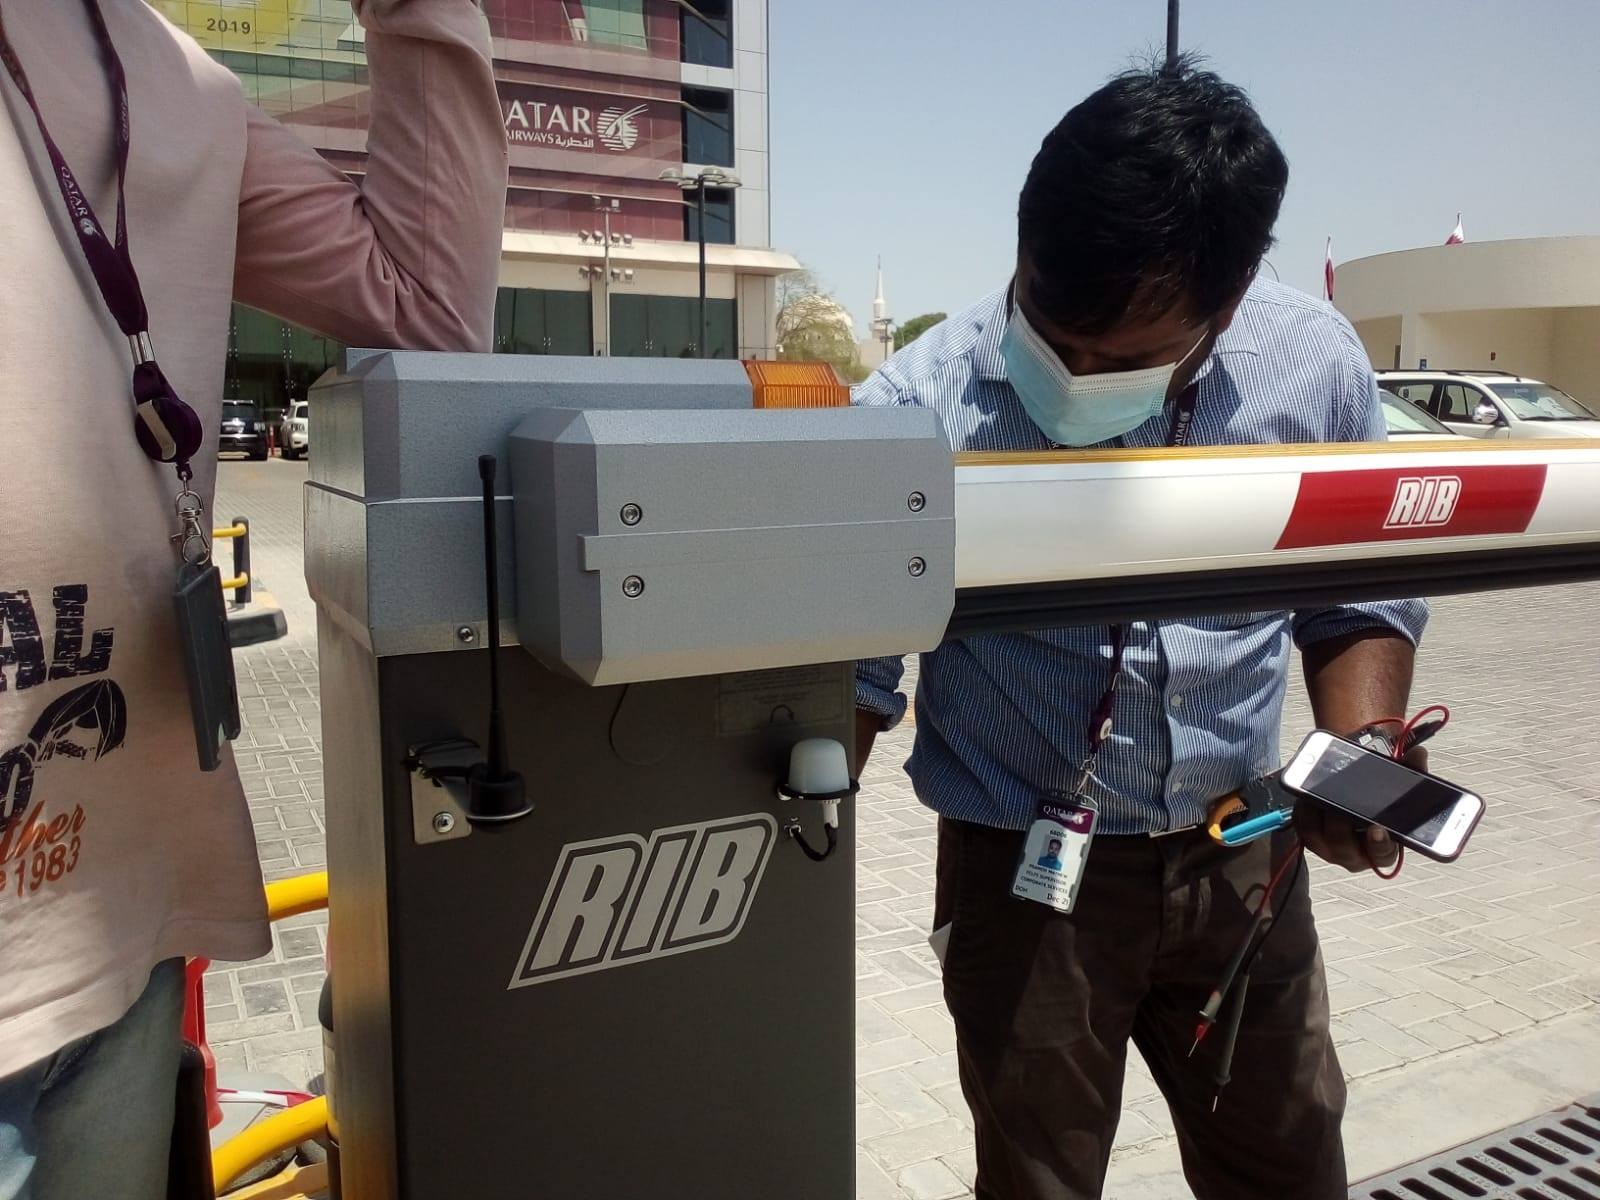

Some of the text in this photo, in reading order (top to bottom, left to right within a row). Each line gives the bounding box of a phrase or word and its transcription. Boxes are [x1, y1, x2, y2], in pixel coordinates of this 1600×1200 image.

[206, 17, 251, 35] 2019
[505, 99, 593, 134] ATAR
[61, 166, 88, 216] QATAR
[1383, 475, 1462, 529] RIB
[15, 835, 81, 897] 1983
[508, 812, 778, 990] RIB
[1047, 893, 1060, 902] Dec
